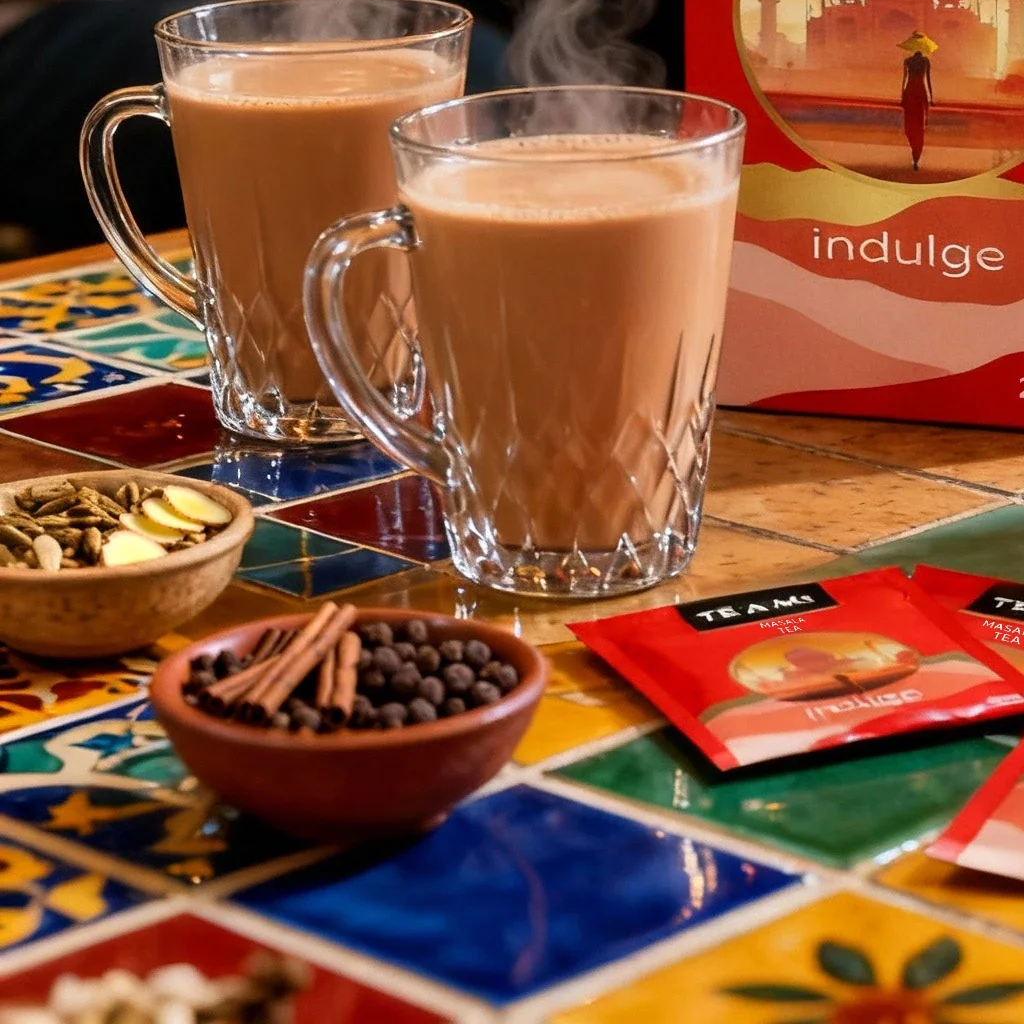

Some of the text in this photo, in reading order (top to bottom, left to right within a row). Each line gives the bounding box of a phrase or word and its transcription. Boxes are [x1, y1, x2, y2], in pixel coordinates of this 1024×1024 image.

[813, 227, 1005, 278] indulge
[759, 617, 806, 630] MASALA
[777, 625, 803, 635] TEA
[993, 631, 1021, 645] TEA
